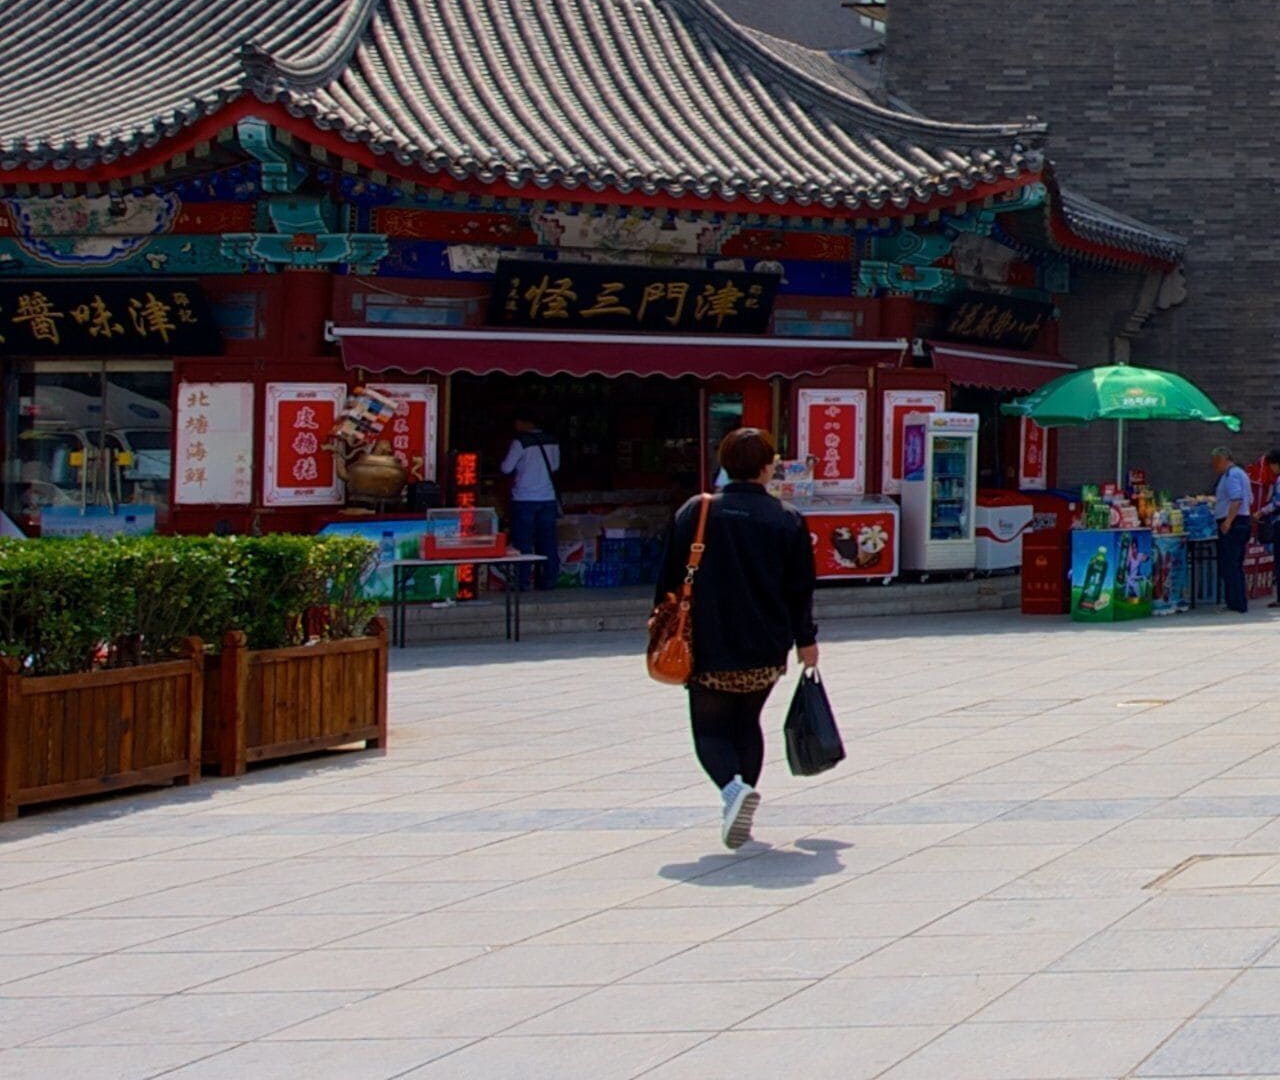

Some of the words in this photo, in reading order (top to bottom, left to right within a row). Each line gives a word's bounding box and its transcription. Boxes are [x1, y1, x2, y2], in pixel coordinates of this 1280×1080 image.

[0, 290, 177, 345] 津味醬
[524, 274, 744, 327] 津門三怪
